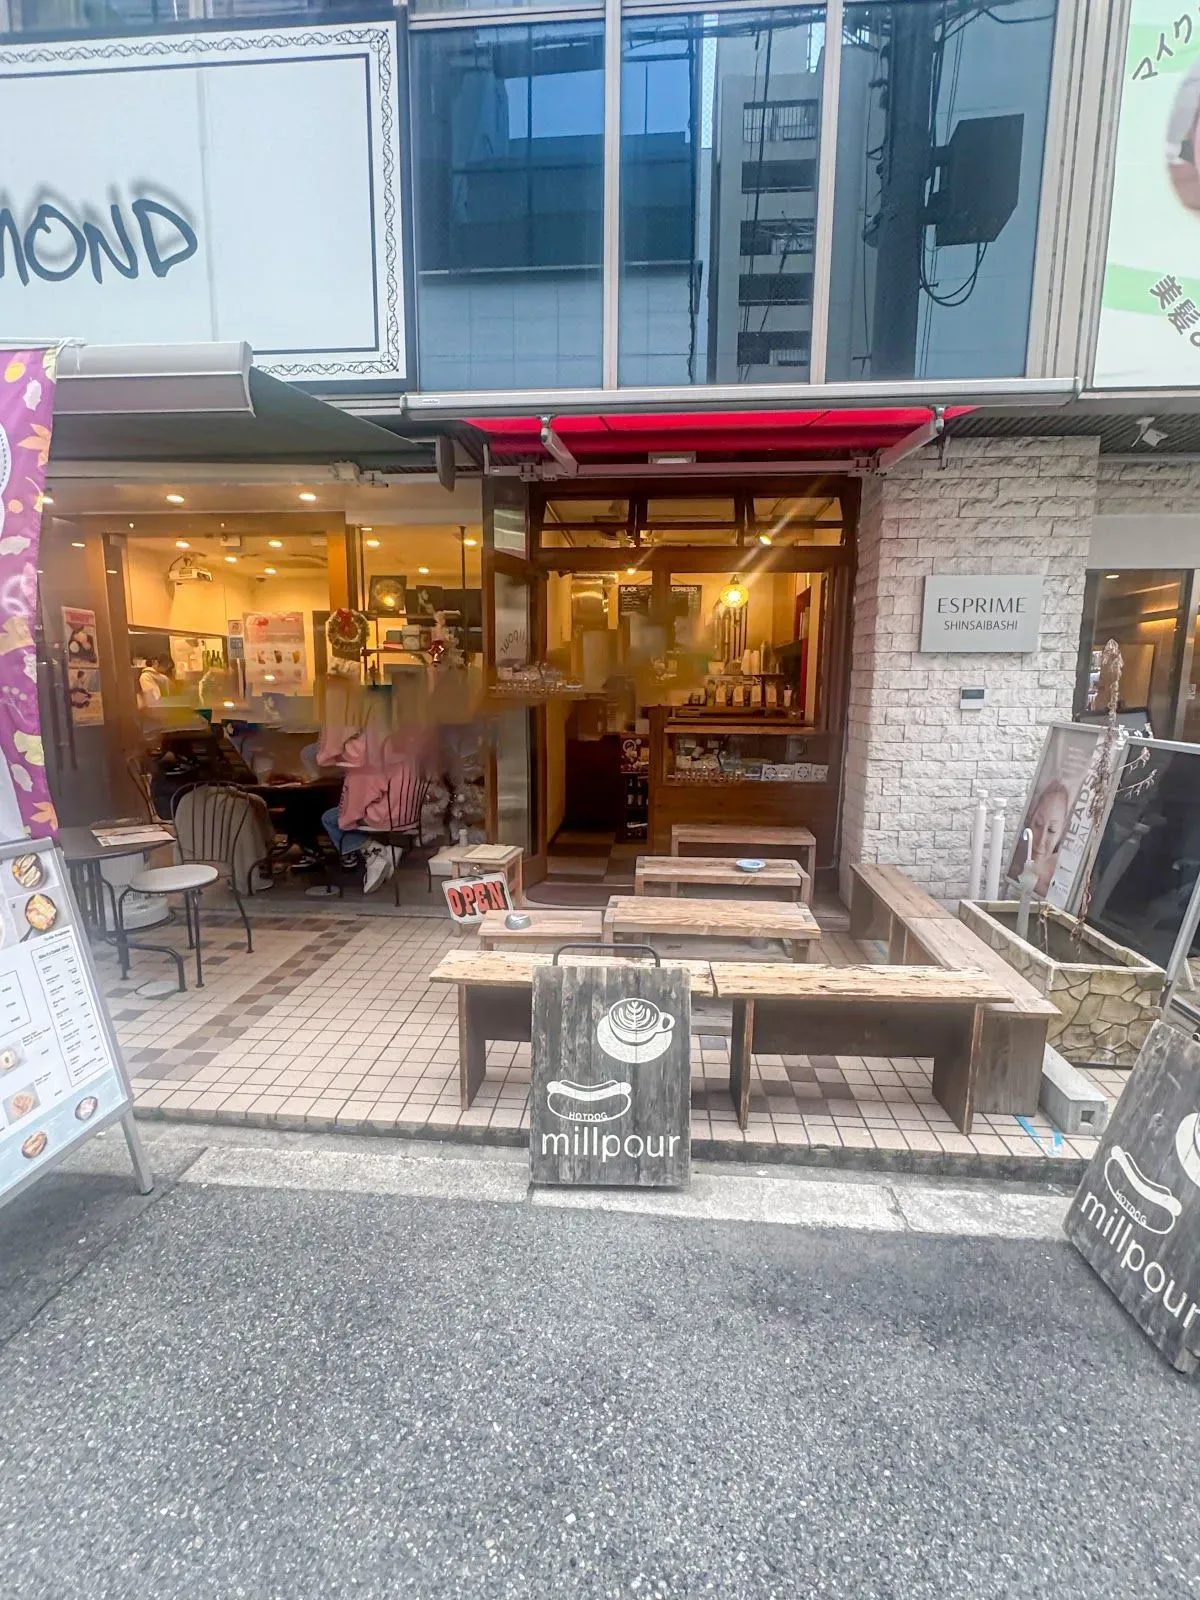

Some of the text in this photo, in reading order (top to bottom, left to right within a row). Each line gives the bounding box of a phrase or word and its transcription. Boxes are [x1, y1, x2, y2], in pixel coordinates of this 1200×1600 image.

[1132, 6, 1200, 80] マイク
[937, 597, 1028, 614] ESPRIME
[943, 620, 1018, 631] SHINSAIBASHI
[448, 881, 508, 917] OPEN
[568, 1111, 608, 1122] HOTDOG
[541, 1126, 681, 1163] millpour
[1114, 1189, 1147, 1226] HOTDOG
[1081, 1191, 1200, 1329] millpour
